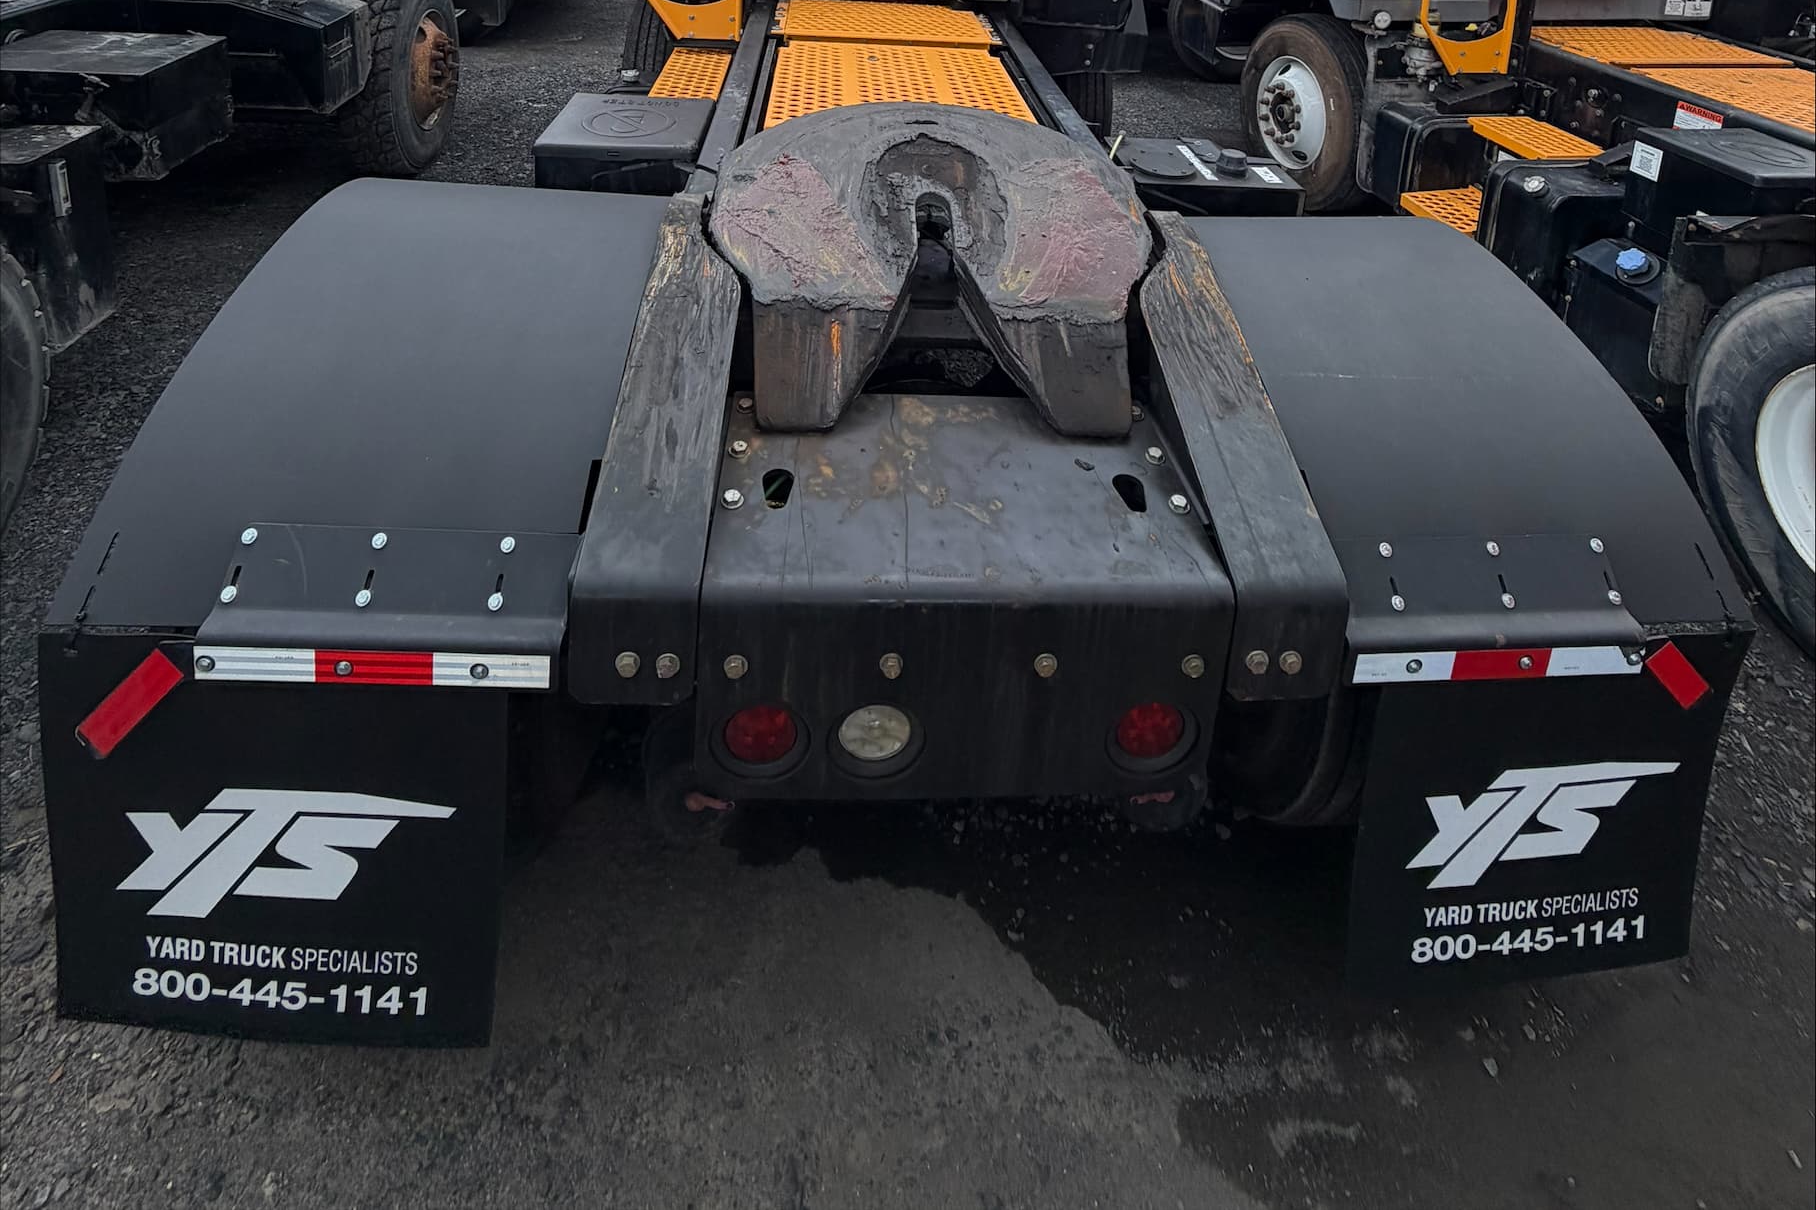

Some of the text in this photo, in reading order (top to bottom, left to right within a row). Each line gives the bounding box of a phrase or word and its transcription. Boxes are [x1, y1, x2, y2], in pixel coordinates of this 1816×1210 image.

[1684, 103, 1723, 123] WARNING
[1406, 762, 1680, 889] YTS
[116, 789, 456, 918] YTS
[1424, 888, 1639, 928] YARD TRUCK SPECIALISTS
[146, 935, 418, 976] YARD TRUCK SPECIALISTS
[1411, 915, 1645, 963] 800-445-1141
[133, 968, 428, 1016] 800-445-1141
